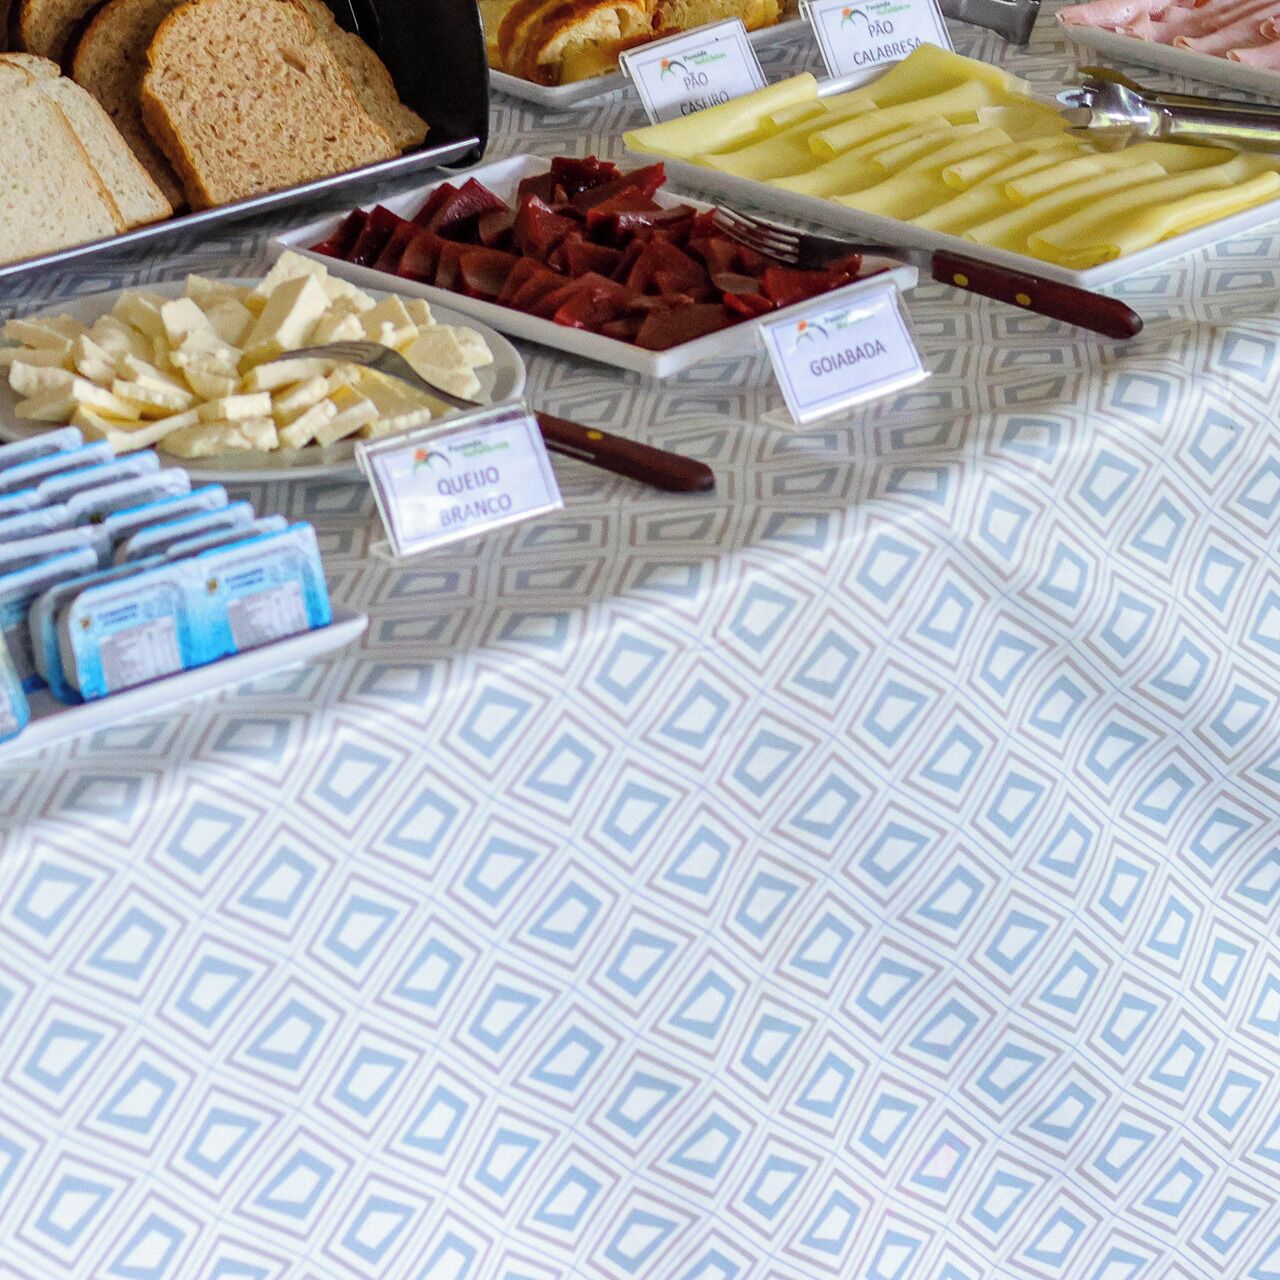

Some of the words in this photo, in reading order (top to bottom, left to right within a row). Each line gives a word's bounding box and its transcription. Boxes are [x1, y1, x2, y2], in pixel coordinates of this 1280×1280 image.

[868, 19, 894, 38] PÃO
[853, 36, 922, 66] CALABRESA
[683, 71, 709, 91] PÃO
[810, 339, 887, 377] GOIABADA
[437, 465, 500, 497] QUEIJO
[440, 493, 512, 527] BRANCO
